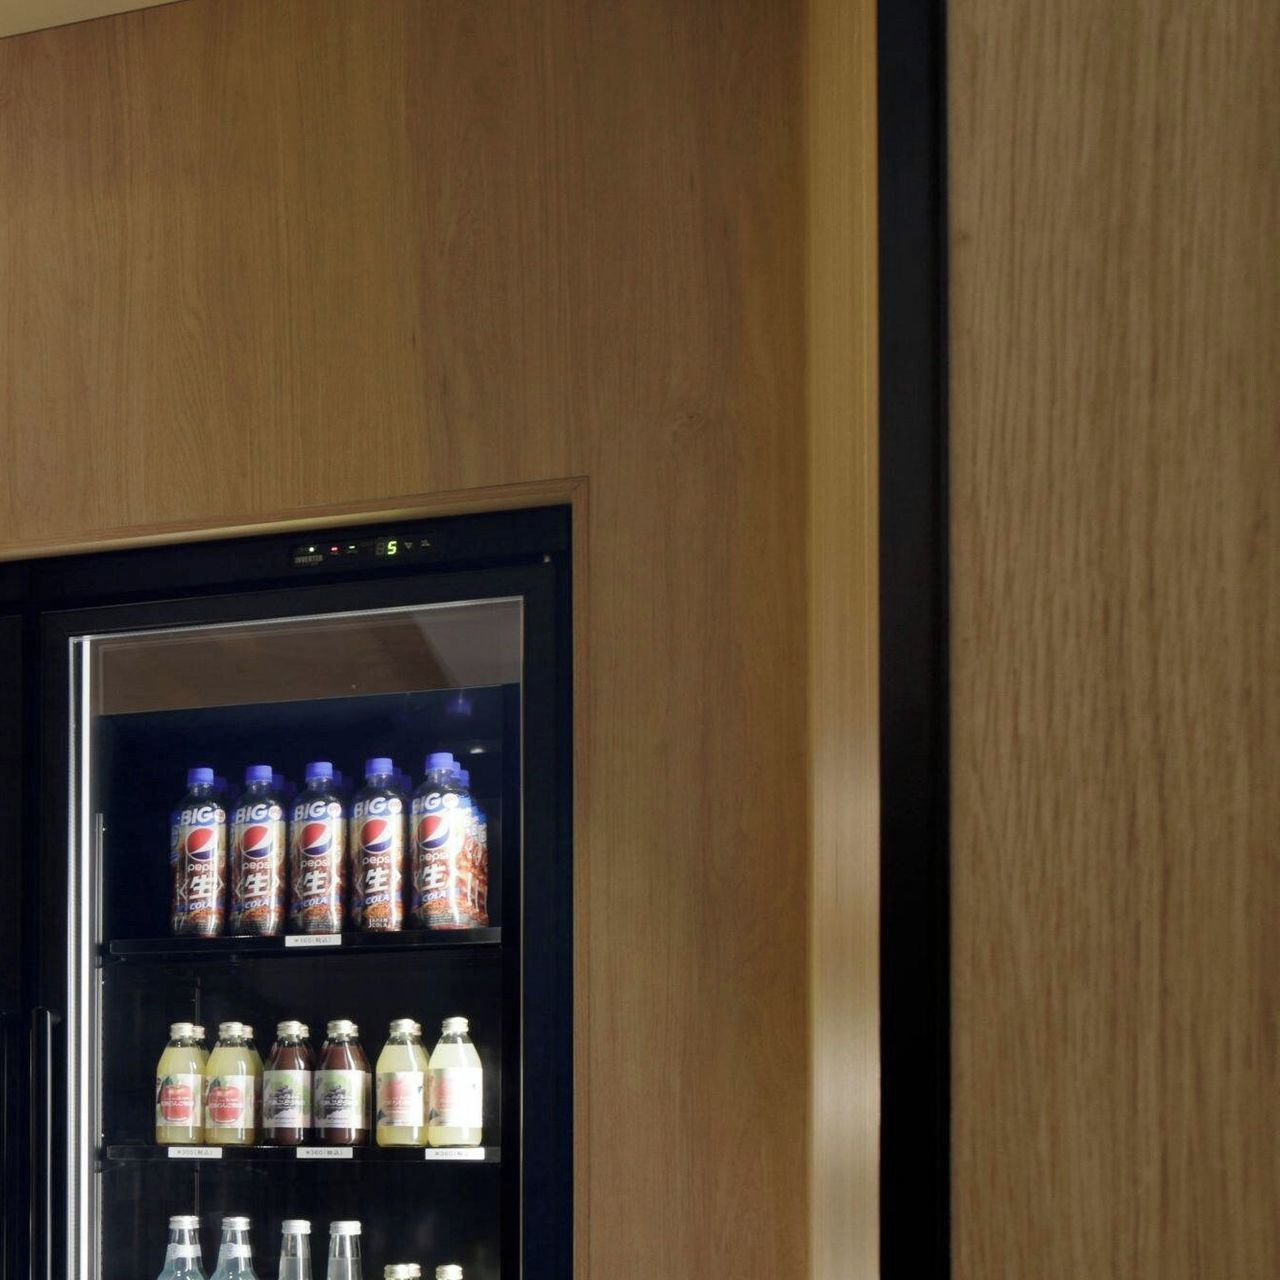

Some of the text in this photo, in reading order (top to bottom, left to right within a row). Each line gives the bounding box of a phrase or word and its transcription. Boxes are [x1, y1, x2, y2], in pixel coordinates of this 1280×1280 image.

[235, 803, 268, 824] BIG
[293, 800, 326, 822] BIG
[353, 796, 387, 818] BIG
[411, 792, 441, 815] BIG
[180, 805, 214, 826] BIG
[241, 861, 272, 871] peps
[300, 858, 330, 869] peps
[190, 874, 213, 900] 生
[241, 872, 271, 898] 生
[303, 870, 328, 897] 生
[364, 865, 390, 894] 生
[422, 863, 446, 891] 生
[190, 900, 215, 911] COLA
[244, 899, 270, 910] COLA
[303, 896, 328, 908] COLA
[365, 893, 390, 905] COLA
[422, 890, 448, 902] COLA
